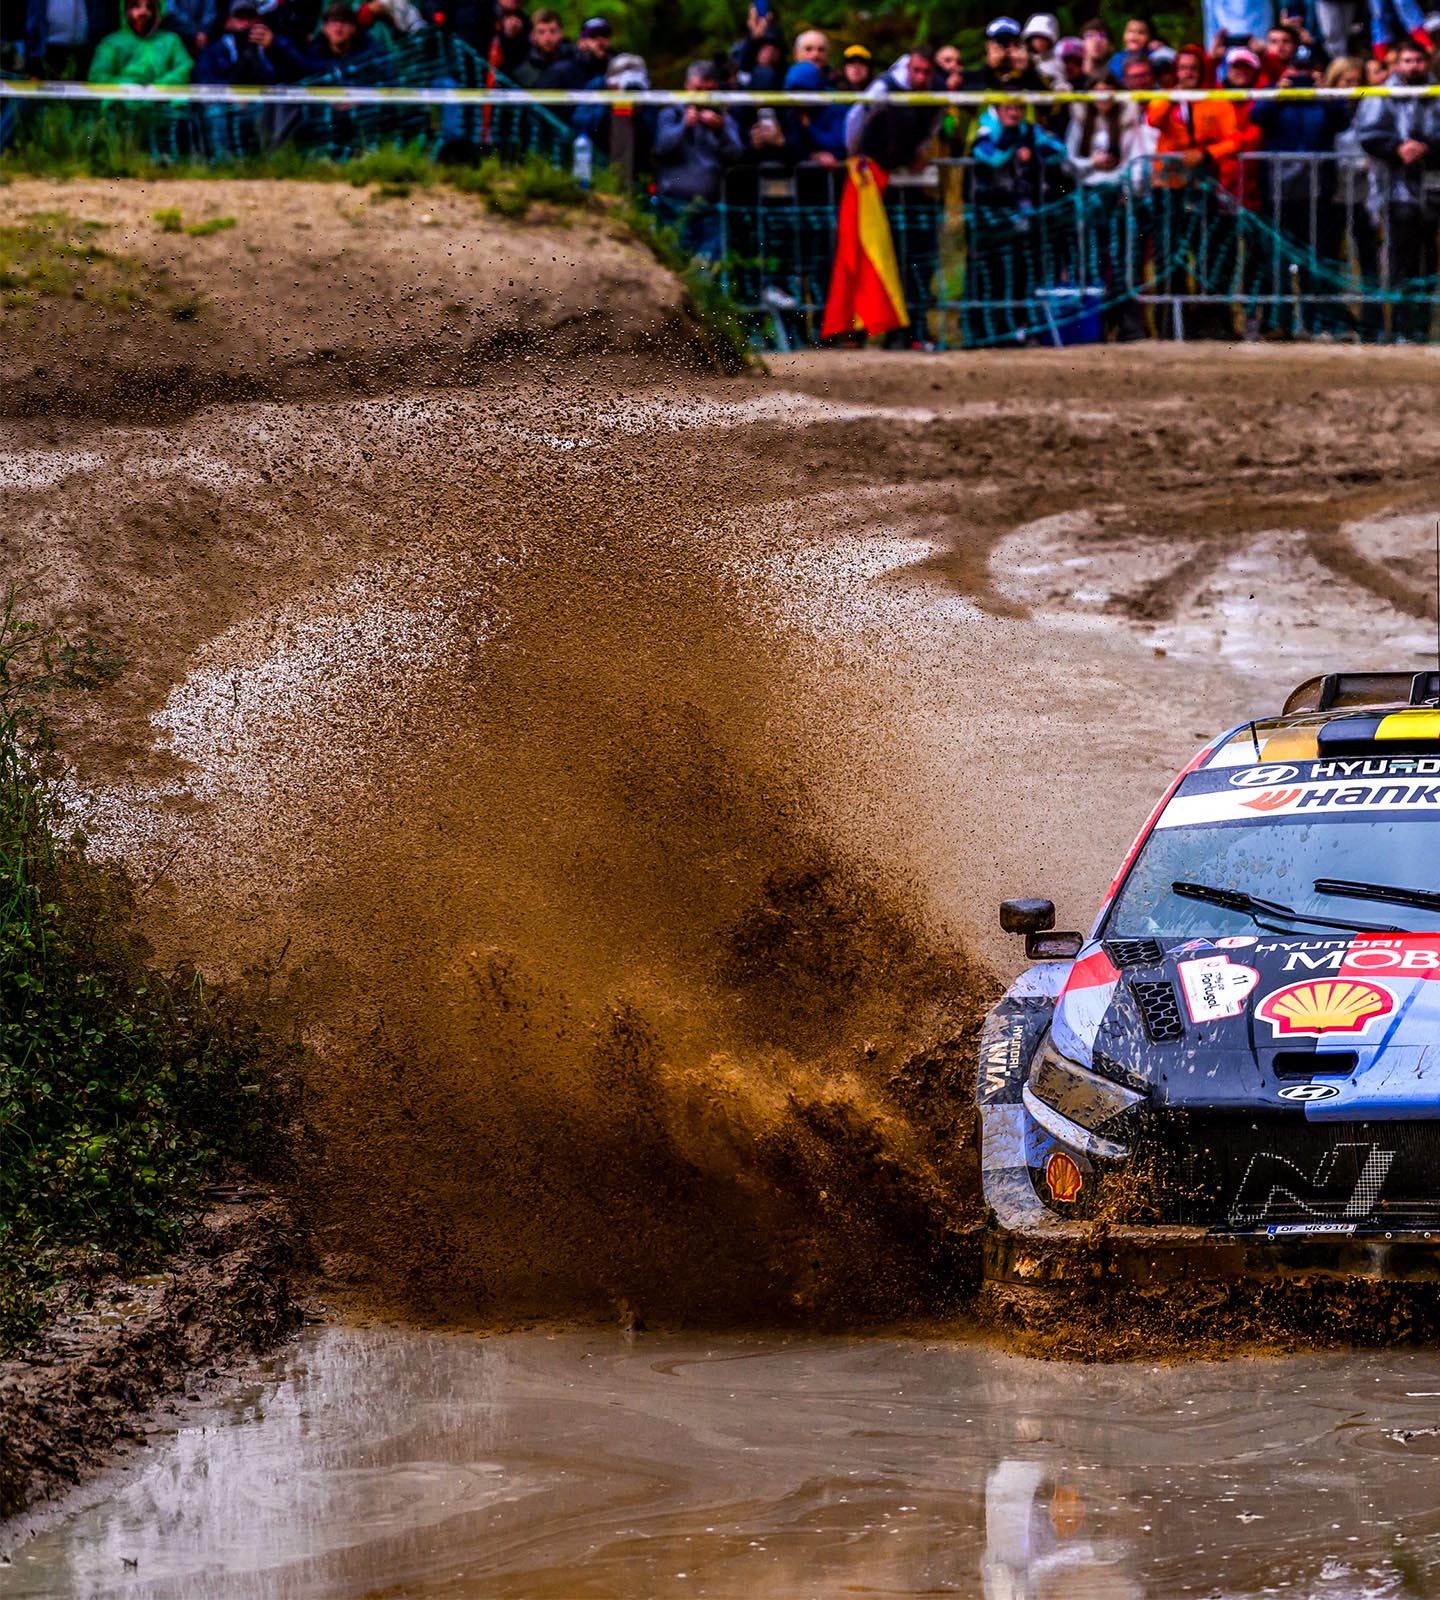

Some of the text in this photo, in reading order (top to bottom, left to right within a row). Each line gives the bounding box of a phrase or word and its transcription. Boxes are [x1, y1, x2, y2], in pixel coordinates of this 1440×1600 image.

[1255, 940, 1403, 953] HYUNDAI
[1232, 975, 1248, 985] 11
[1009, 1025, 1023, 1069] HYUNDAI
